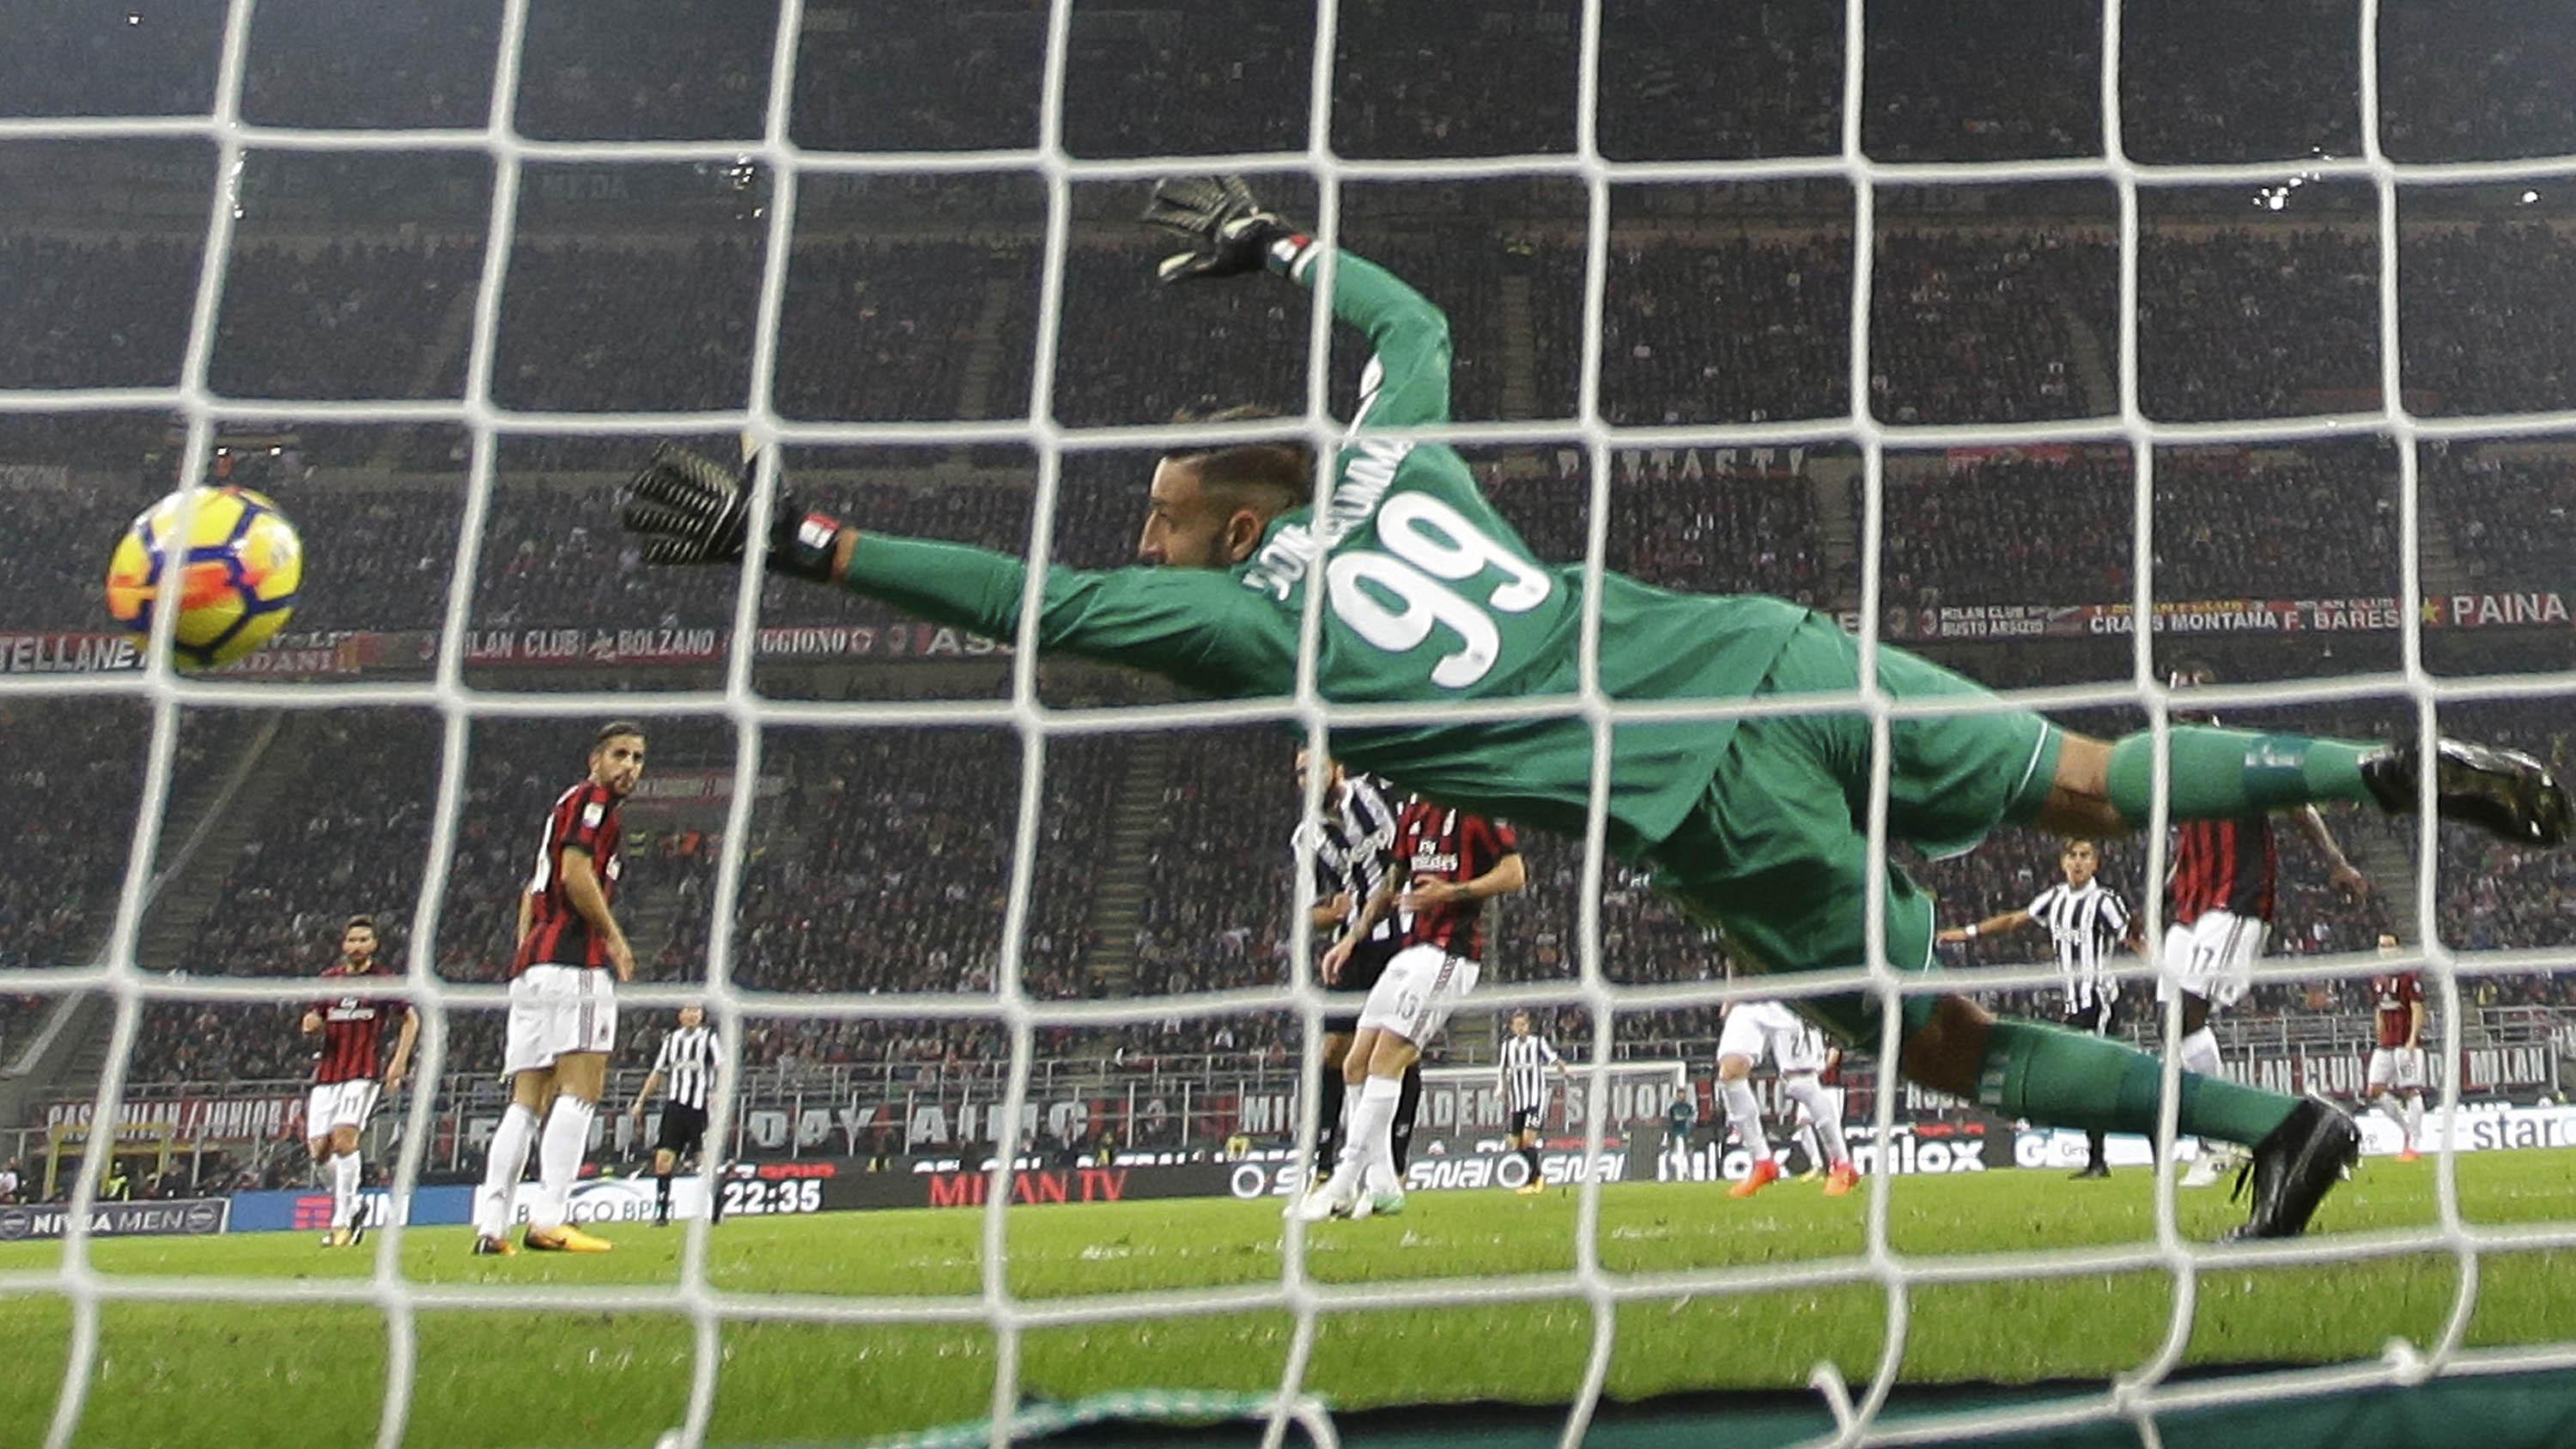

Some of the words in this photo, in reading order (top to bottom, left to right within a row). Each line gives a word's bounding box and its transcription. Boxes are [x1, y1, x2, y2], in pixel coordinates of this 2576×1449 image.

[1327, 490, 1552, 688] 99
[2090, 612, 2165, 634] CRAS
[2171, 610, 2278, 633] MONTANA
[2312, 609, 2401, 629] BARES
[2451, 593, 2570, 626] PAINA
[464, 631, 515, 658] ILAN
[525, 630, 581, 658] CLUB
[617, 628, 716, 657] BOLZANO
[2470, 1047, 2547, 1086] MILAN
[723, 1179, 822, 1214] 22:35
[930, 1172, 1069, 1206] MIAN
[1078, 1170, 1128, 1202] TV
[33, 1211, 112, 1234] NIA
[118, 1210, 184, 1232] MEN
[517, 1199, 615, 1225] BCO
